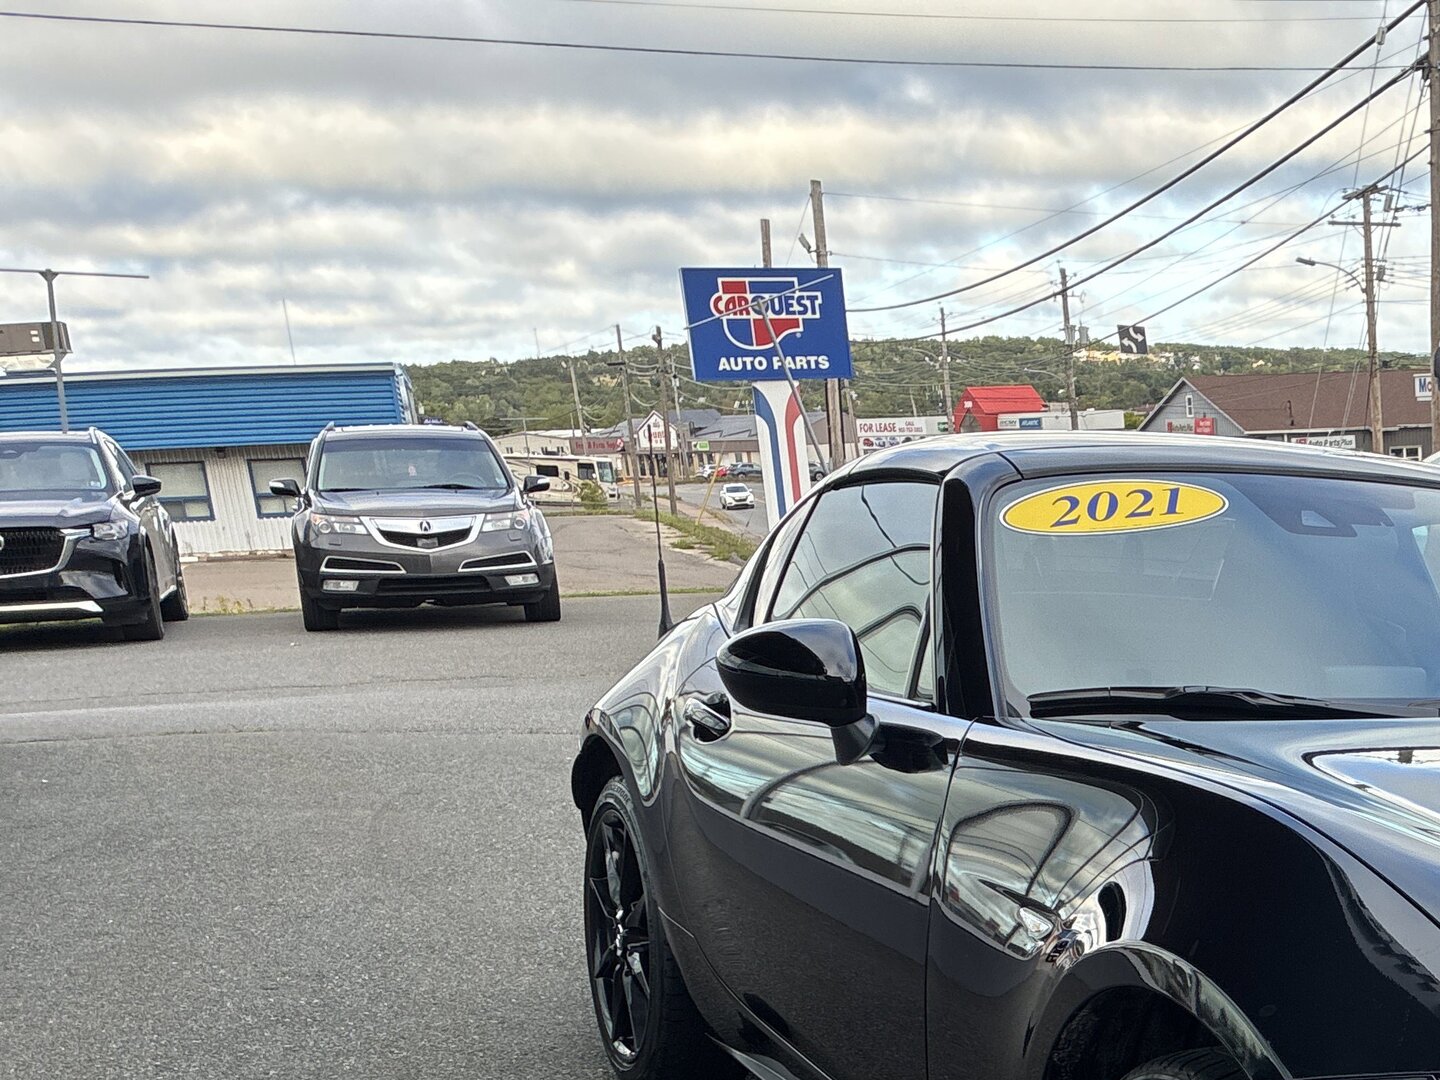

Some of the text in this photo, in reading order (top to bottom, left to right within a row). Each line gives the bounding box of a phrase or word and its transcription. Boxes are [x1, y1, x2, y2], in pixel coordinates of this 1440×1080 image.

[713, 293, 820, 317] CARQUEST
[718, 355, 830, 371] AUTO PARTS
[859, 423, 874, 433] FOR
[875, 422, 897, 433] LEASE
[1050, 486, 1185, 528] 2021
